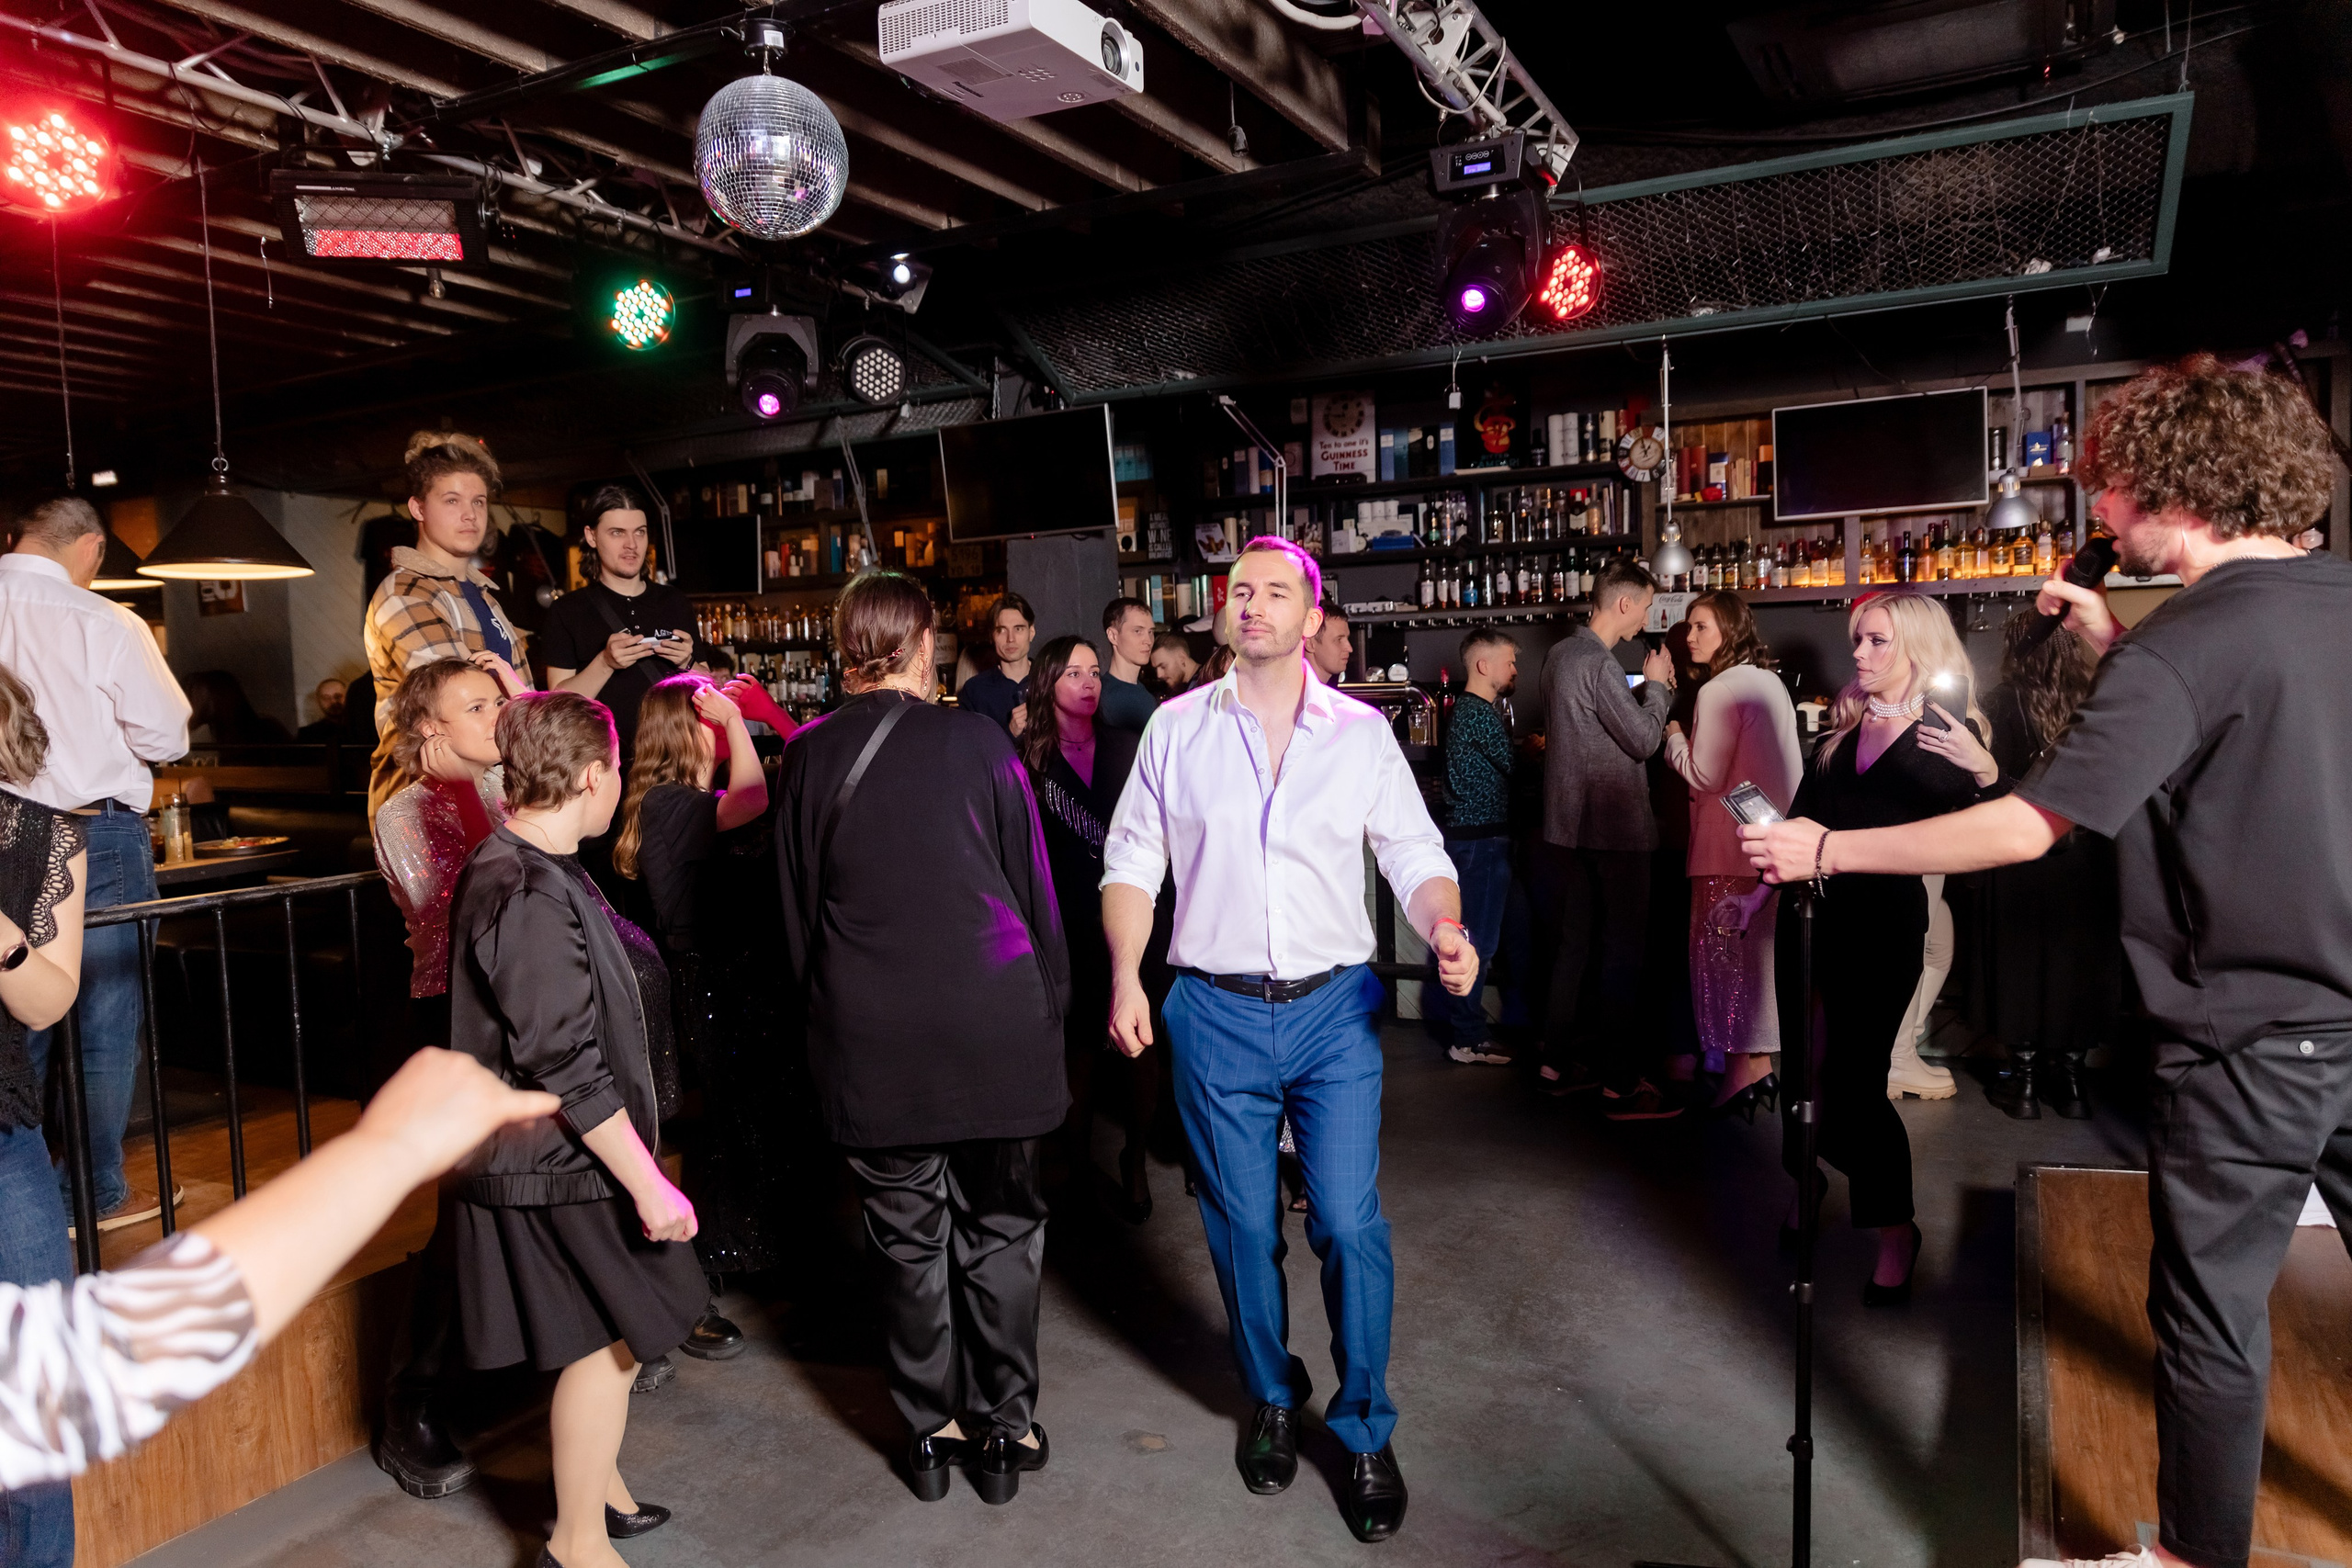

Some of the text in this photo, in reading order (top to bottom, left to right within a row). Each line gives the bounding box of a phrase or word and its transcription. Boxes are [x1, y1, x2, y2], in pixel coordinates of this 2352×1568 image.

[1319, 441, 1332, 449] Ten
[1321, 449, 1368, 461] GUINNESS
[1333, 461, 1355, 471] TIME
